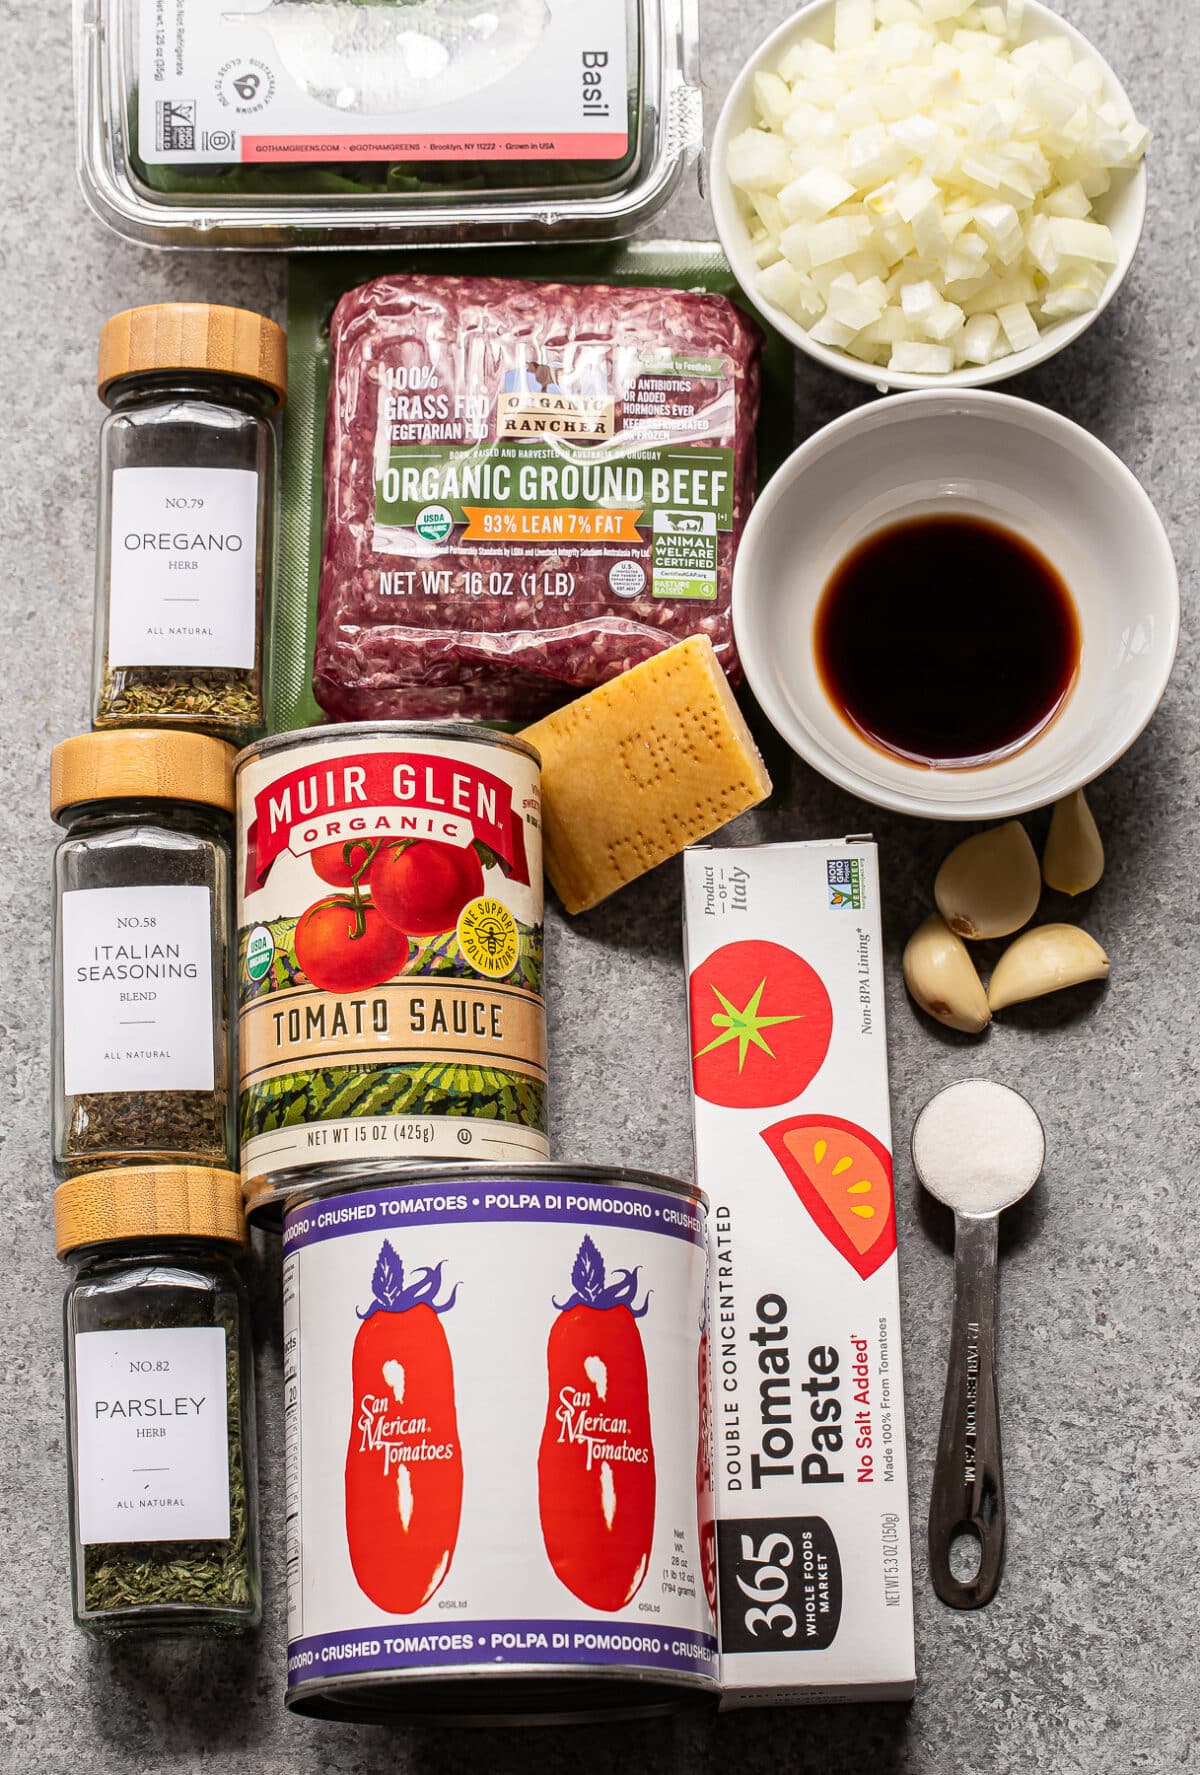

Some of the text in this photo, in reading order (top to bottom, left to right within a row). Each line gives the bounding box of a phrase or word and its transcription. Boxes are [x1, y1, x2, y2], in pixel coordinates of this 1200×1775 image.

[156, 48, 163, 57] oz
[174, 28, 184, 76] Refrigerate
[582, 51, 609, 117] Basil
[163, 102, 171, 150] VERIFIED
[178, 127, 186, 149] GMO
[185, 127, 193, 149] NON
[255, 144, 340, 153] GOTHAMGREENS.COM
[349, 143, 420, 152] @GOTHAMGREENS
[505, 142, 555, 150] Grown in USA
[385, 366, 438, 390] 100%
[638, 380, 692, 392] ANTIBIOTICS
[384, 394, 449, 420] GRASS
[638, 392, 666, 403] ADDED
[623, 403, 695, 417] HORMONES EVER
[385, 423, 462, 440] VEGETARIAN
[505, 420, 607, 433] RANCHER
[501, 449, 516, 458] AND
[518, 449, 560, 459] HARVESTED
[383, 465, 728, 507] ORGANIC GROUND BEEF
[165, 498, 204, 509] NO.79
[423, 513, 445, 523] USDA
[483, 514, 624, 534] 93% LEAN 7% FAT
[124, 533, 243, 552] OREGANO
[655, 536, 714, 549] ANIMAL
[655, 547, 714, 559] WELFARE
[168, 561, 199, 570] HERB
[655, 557, 714, 568] CERTIFIED
[379, 571, 575, 597] NET WT. 16 OZ (1 LB)
[147, 627, 213, 636] ALL NATURAL
[268, 763, 497, 835] MUIR GLEN
[303, 815, 459, 843] ORGANIC
[828, 860, 837, 883] NON
[836, 860, 844, 883] GMO
[703, 866, 716, 916] Product
[718, 884, 728, 899] OF
[728, 866, 750, 911] Italy
[851, 860, 860, 908] VERIFIED
[117, 917, 157, 929] NO.58
[463, 902, 515, 934] WE SUPPORT
[95, 944, 179, 961] ITALIAN
[250, 936, 267, 953] USDA
[463, 938, 516, 971] POLLINATORS
[77, 963, 198, 982] SEASONING
[119, 991, 157, 1002] BLEND
[859, 977, 873, 1035] Non-BPA
[272, 998, 504, 1047] TOMATO SAUCE
[104, 1050, 171, 1060] ALL NATURAL
[307, 1123, 435, 1147] NET WT 15 OZ (425g)
[317, 1193, 700, 1233] CRUSHED TOMATOES POLPA DI POMODORO CRUSHED
[716, 1205, 742, 1491] DOUBLE CONCENTRATED
[129, 1361, 170, 1373] NO.82
[749, 1293, 795, 1490] Tomato
[878, 1317, 895, 1482] Made 100% From Tomatoes
[965, 1345, 979, 1436] TABLESPOON
[95, 1397, 207, 1419] PARSLEY
[358, 1394, 389, 1430] San
[555, 1386, 591, 1422] San
[801, 1345, 845, 1484] Paste
[136, 1428, 167, 1438] HERB
[855, 1411, 872, 1451] Salt
[374, 1440, 454, 1476] Tomatoes
[575, 1434, 649, 1472] Tomatoes
[856, 1454, 874, 1483] No
[117, 1498, 185, 1509] ALL NATURAL
[673, 1529, 685, 1539] Net
[671, 1556, 688, 1568] 28 oz
[880, 1513, 900, 1607] NET WT 5.3 OZ (150g)
[663, 1569, 669, 1579] (1
[671, 1570, 678, 1579] lb
[679, 1572, 686, 1581] 12
[736, 1532, 797, 1638] 365
[802, 1531, 817, 1636] WHOLE FOODS
[817, 1553, 830, 1612] MARKET
[661, 1582, 696, 1600] (794 grams)
[321, 1633, 711, 1662] CRUSHED TOMATOES POLPA DI POMODORO CRUSHED
